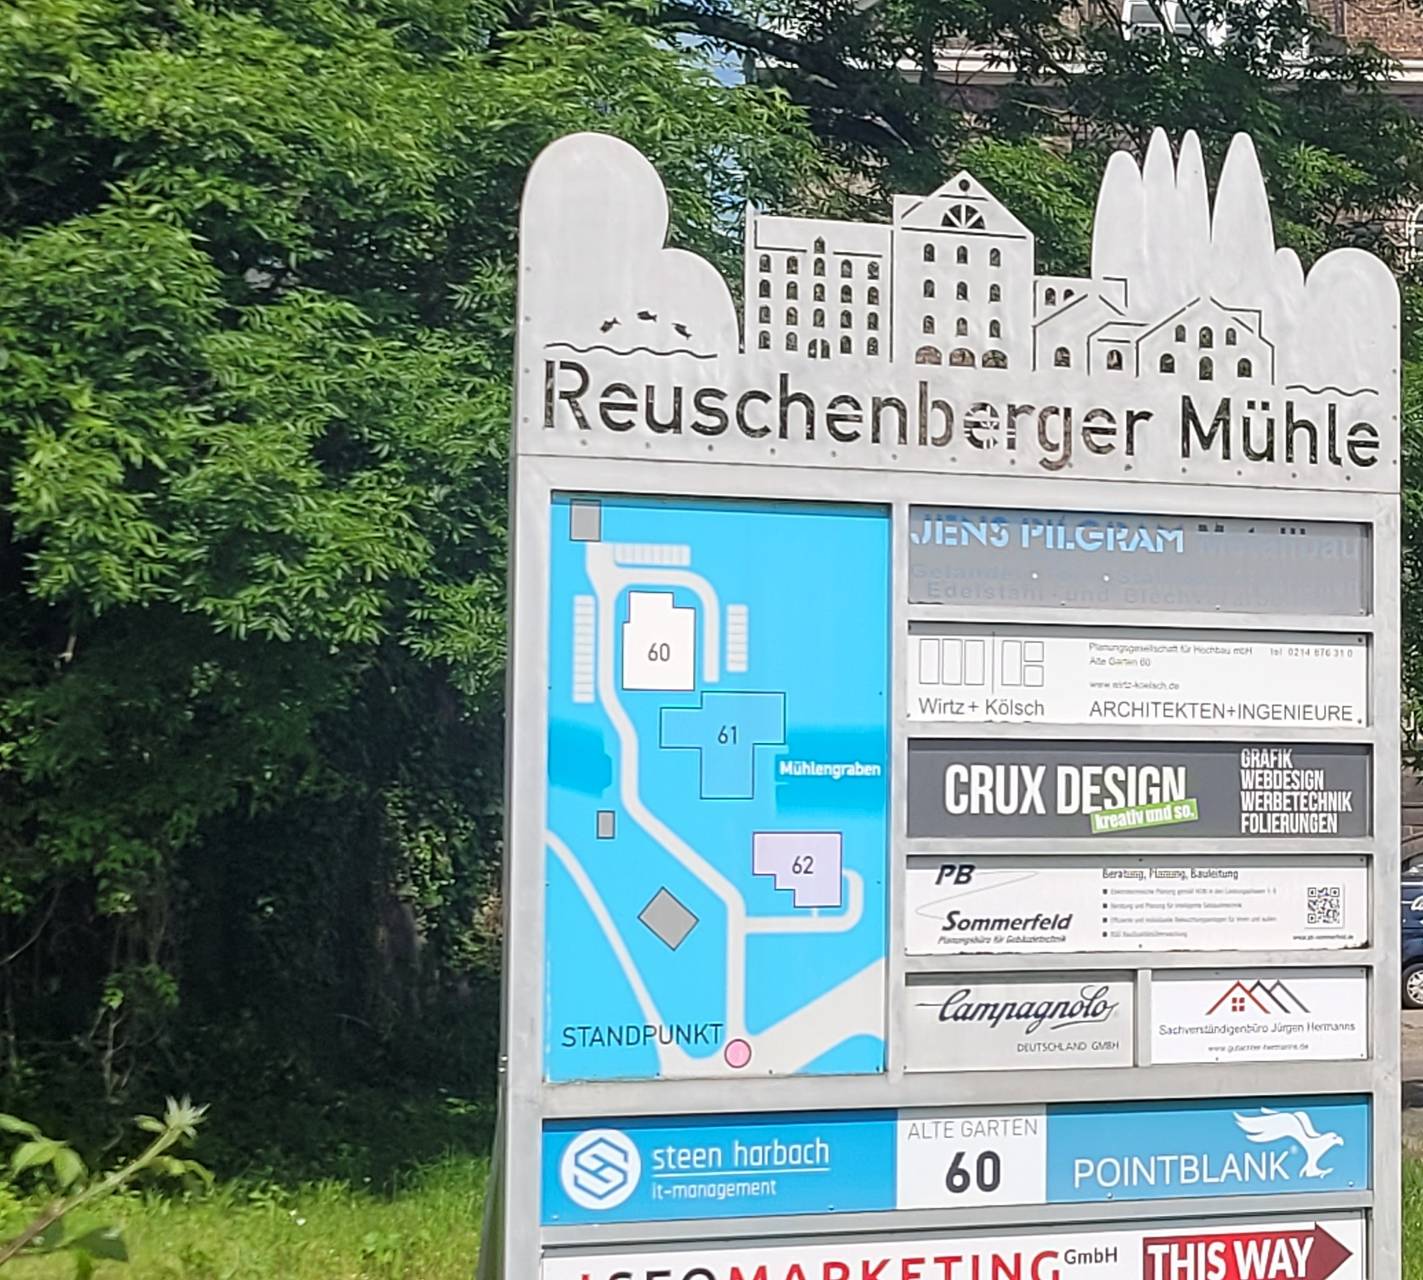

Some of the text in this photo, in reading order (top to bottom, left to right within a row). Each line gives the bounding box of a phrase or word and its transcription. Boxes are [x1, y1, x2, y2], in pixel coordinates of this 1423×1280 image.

[543, 359, 1380, 471] Reuschenberger Mühle
[910, 514, 1184, 553] JENS PILGRAM
[647, 642, 671, 663] 60
[918, 696, 966, 715] Wirtz
[985, 698, 1045, 716] Kölsch
[1089, 700, 1353, 721] ARCHITEKTEN+INGENIEURE
[717, 726, 739, 745] 61
[1241, 748, 1293, 768] GRAFIK
[779, 760, 882, 780] Mühlengraben
[1240, 769, 1324, 790] WEBDESIGN
[945, 764, 1186, 815] CRUX DESIGN
[1240, 791, 1352, 812] WERBETECHNIK
[1095, 800, 1195, 831] kreativ und so.
[1241, 813, 1338, 833] FOLIERUNGEN
[792, 856, 814, 875] 62
[935, 864, 976, 885] PB
[941, 910, 1073, 931] Sommerfeld
[915, 985, 1119, 1035] Campagnolo
[561, 1023, 723, 1047] STANDPUNKT
[1159, 1021, 1356, 1036] Sachverständigenbüro Jürgen Hermanns
[1016, 1041, 1087, 1052] DEUTSCHLAND
[907, 1117, 1038, 1140] ALTE GARTEN
[652, 1136, 830, 1170] steen harbach
[945, 1150, 1001, 1194] 60
[1074, 1150, 1291, 1189] POINTBLANK
[652, 1180, 777, 1200] it-management
[1064, 1247, 1117, 1265] GmbH
[1147, 1236, 1314, 1280] THIS WAY
